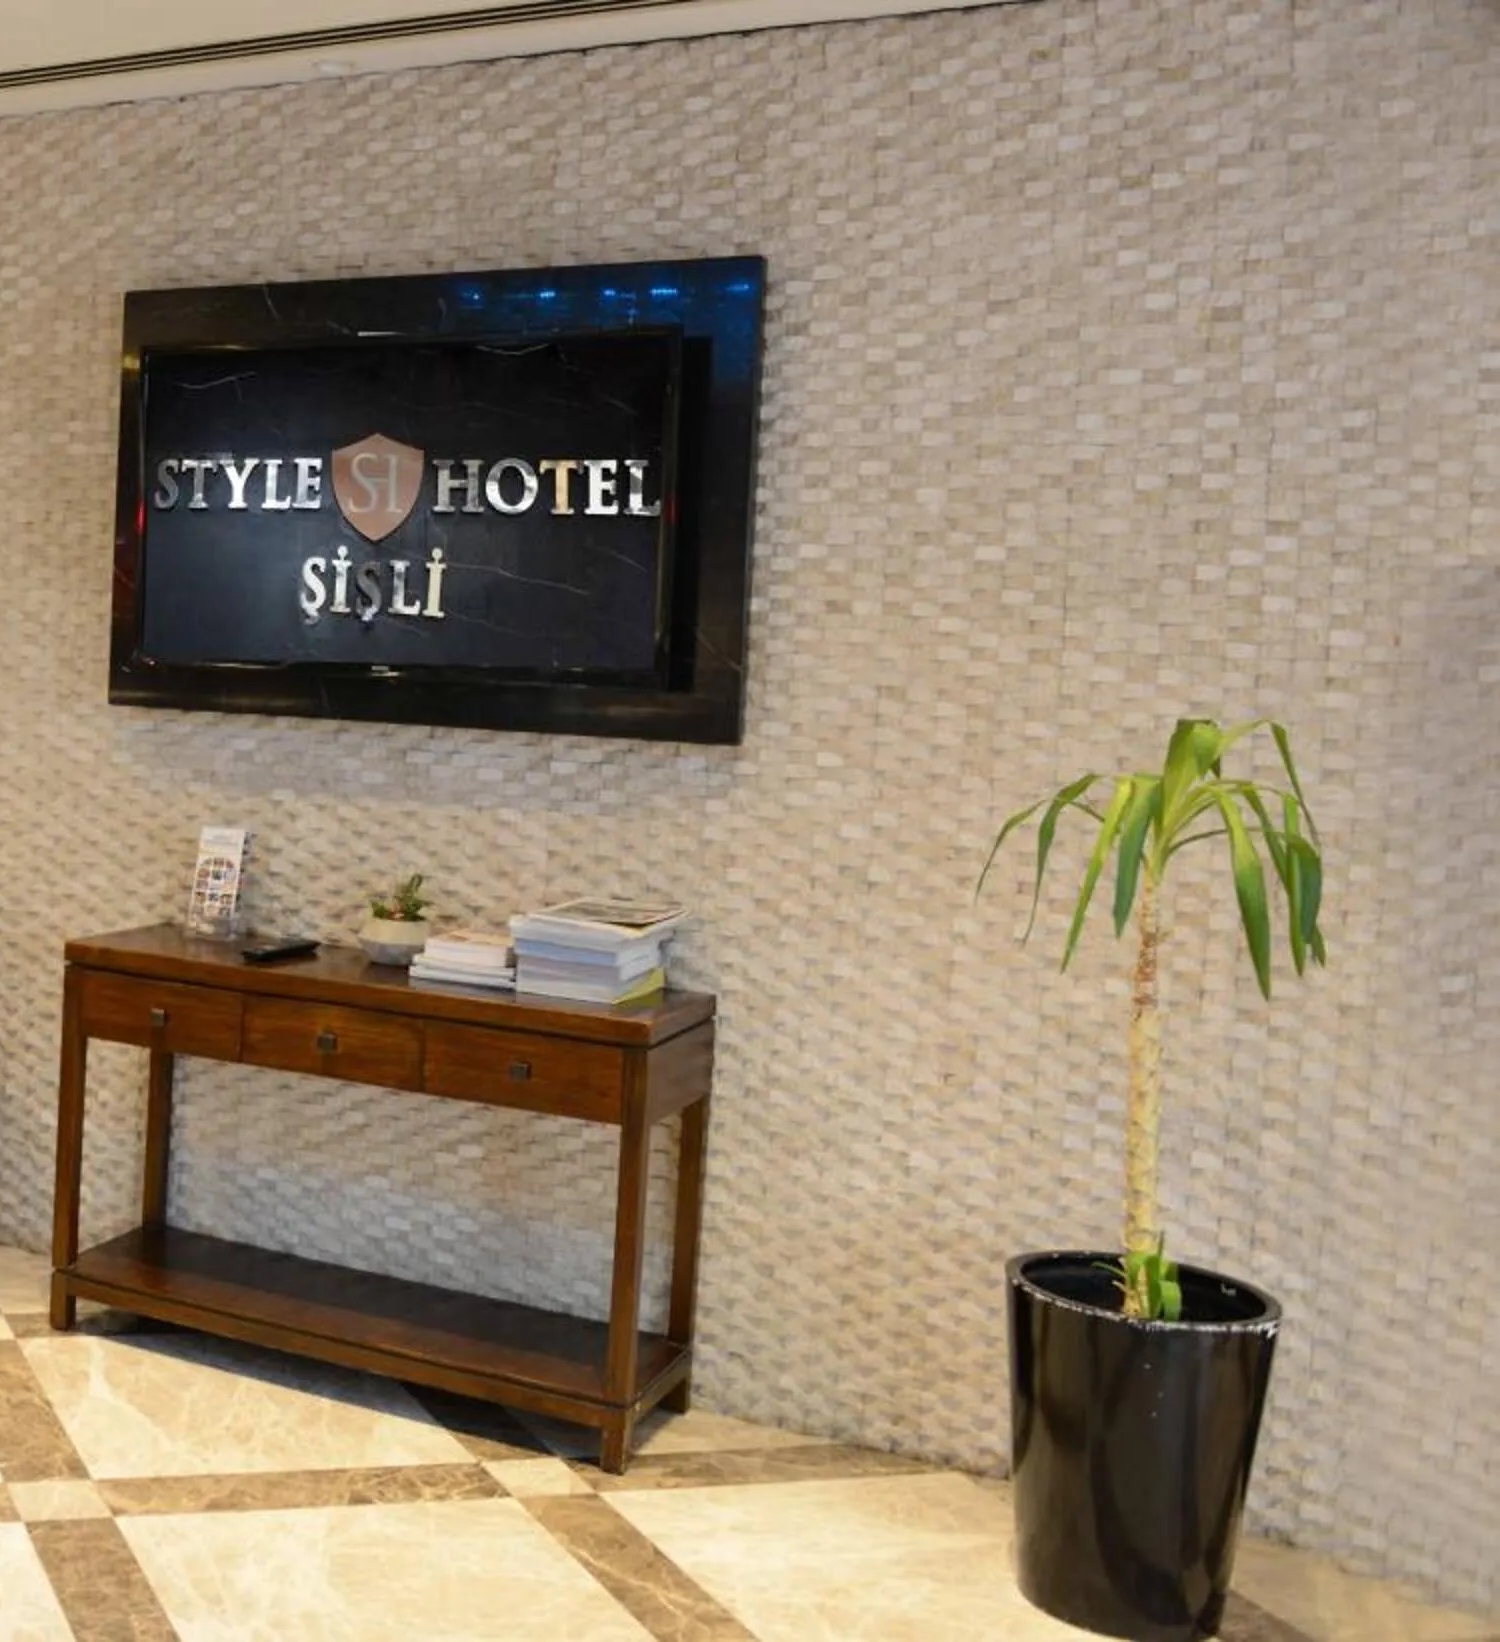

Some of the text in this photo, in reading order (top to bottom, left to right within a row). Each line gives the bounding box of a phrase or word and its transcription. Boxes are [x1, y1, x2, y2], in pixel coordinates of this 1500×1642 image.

[153, 456, 324, 510] STYLE
[431, 456, 662, 516] HOTEL
[299, 545, 447, 625] ŞİŞLİ
